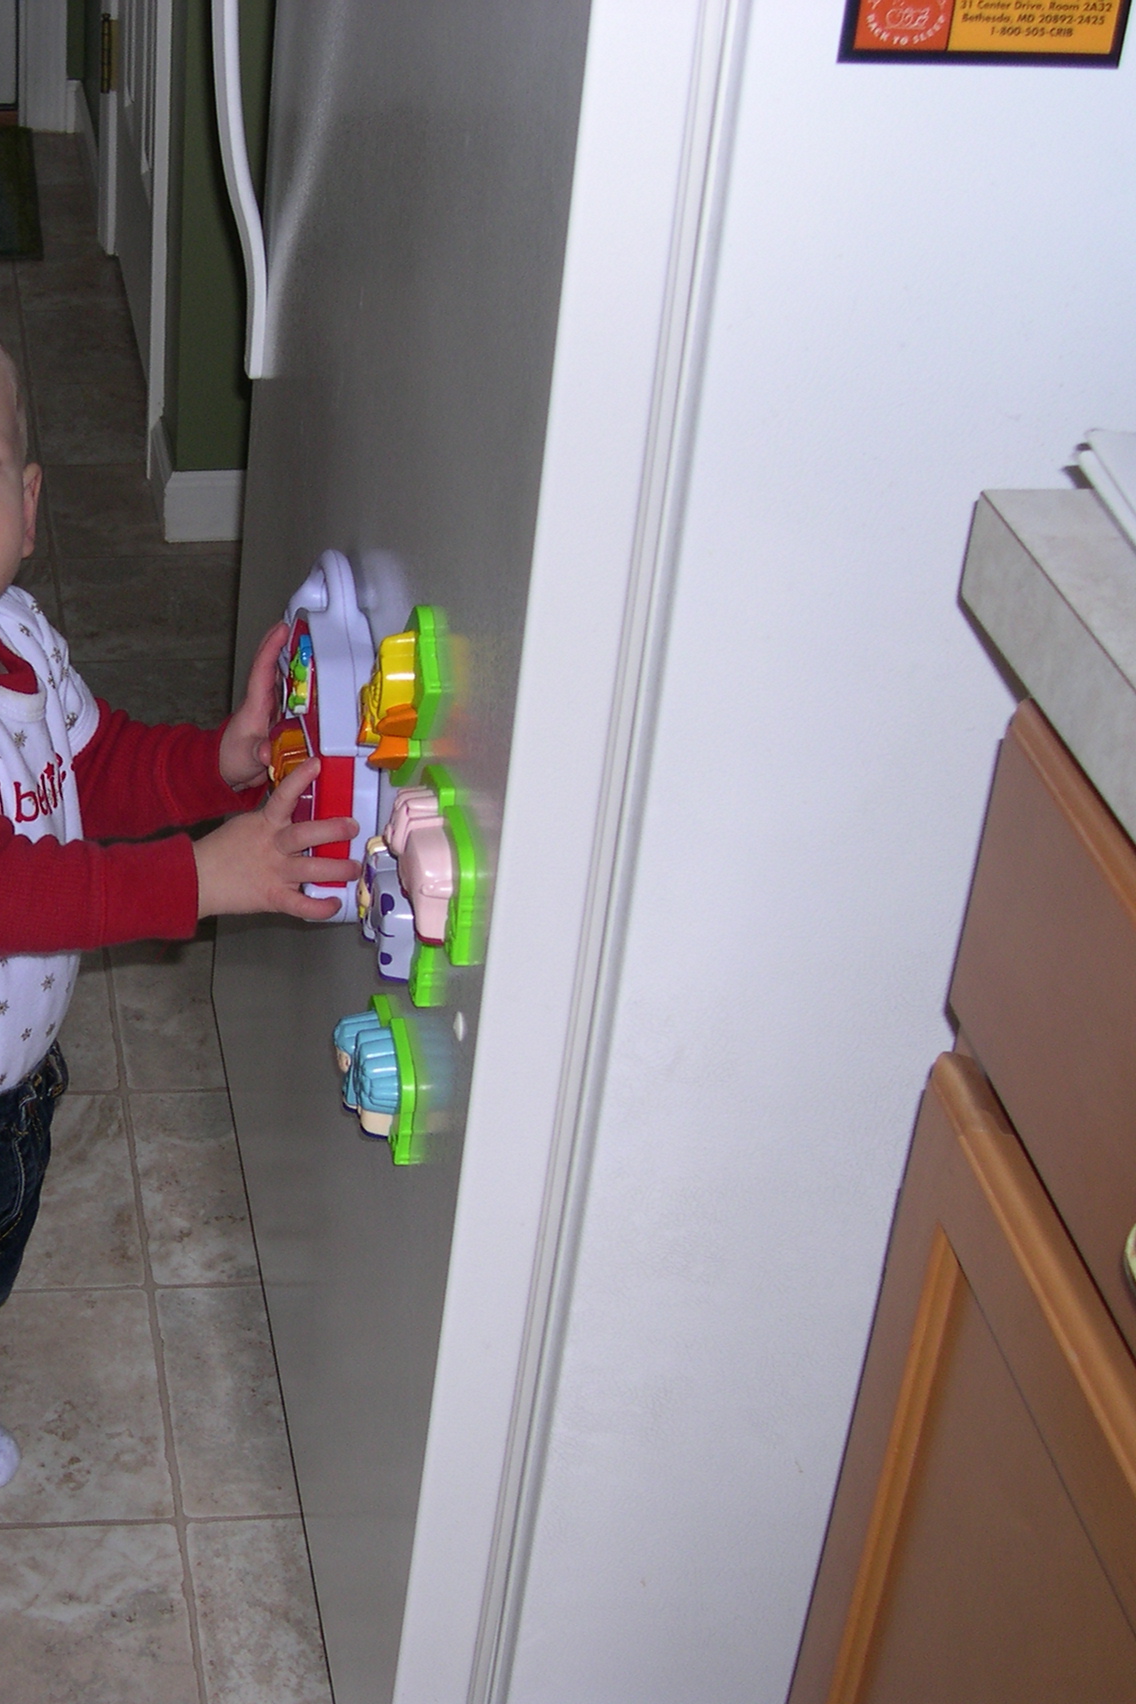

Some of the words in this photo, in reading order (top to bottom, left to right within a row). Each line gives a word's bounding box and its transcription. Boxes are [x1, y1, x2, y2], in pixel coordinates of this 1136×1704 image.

[960, 0, 973, 9] 31
[977, 0, 1012, 10] Center
[1014, 1, 1045, 11] Drive,
[1049, 2, 1080, 11] Room
[1083, 2, 1113, 12] 2A32
[961, 12, 1013, 24] Bethesda,
[1016, 13, 1036, 23] MD
[1038, 14, 1106, 25] 20892-2425
[866, 13, 891, 42] BACK
[892, 35, 909, 46] TO
[912, 14, 946, 45] SLEEP
[990, 26, 1074, 37] 1-800-505-CRIB
